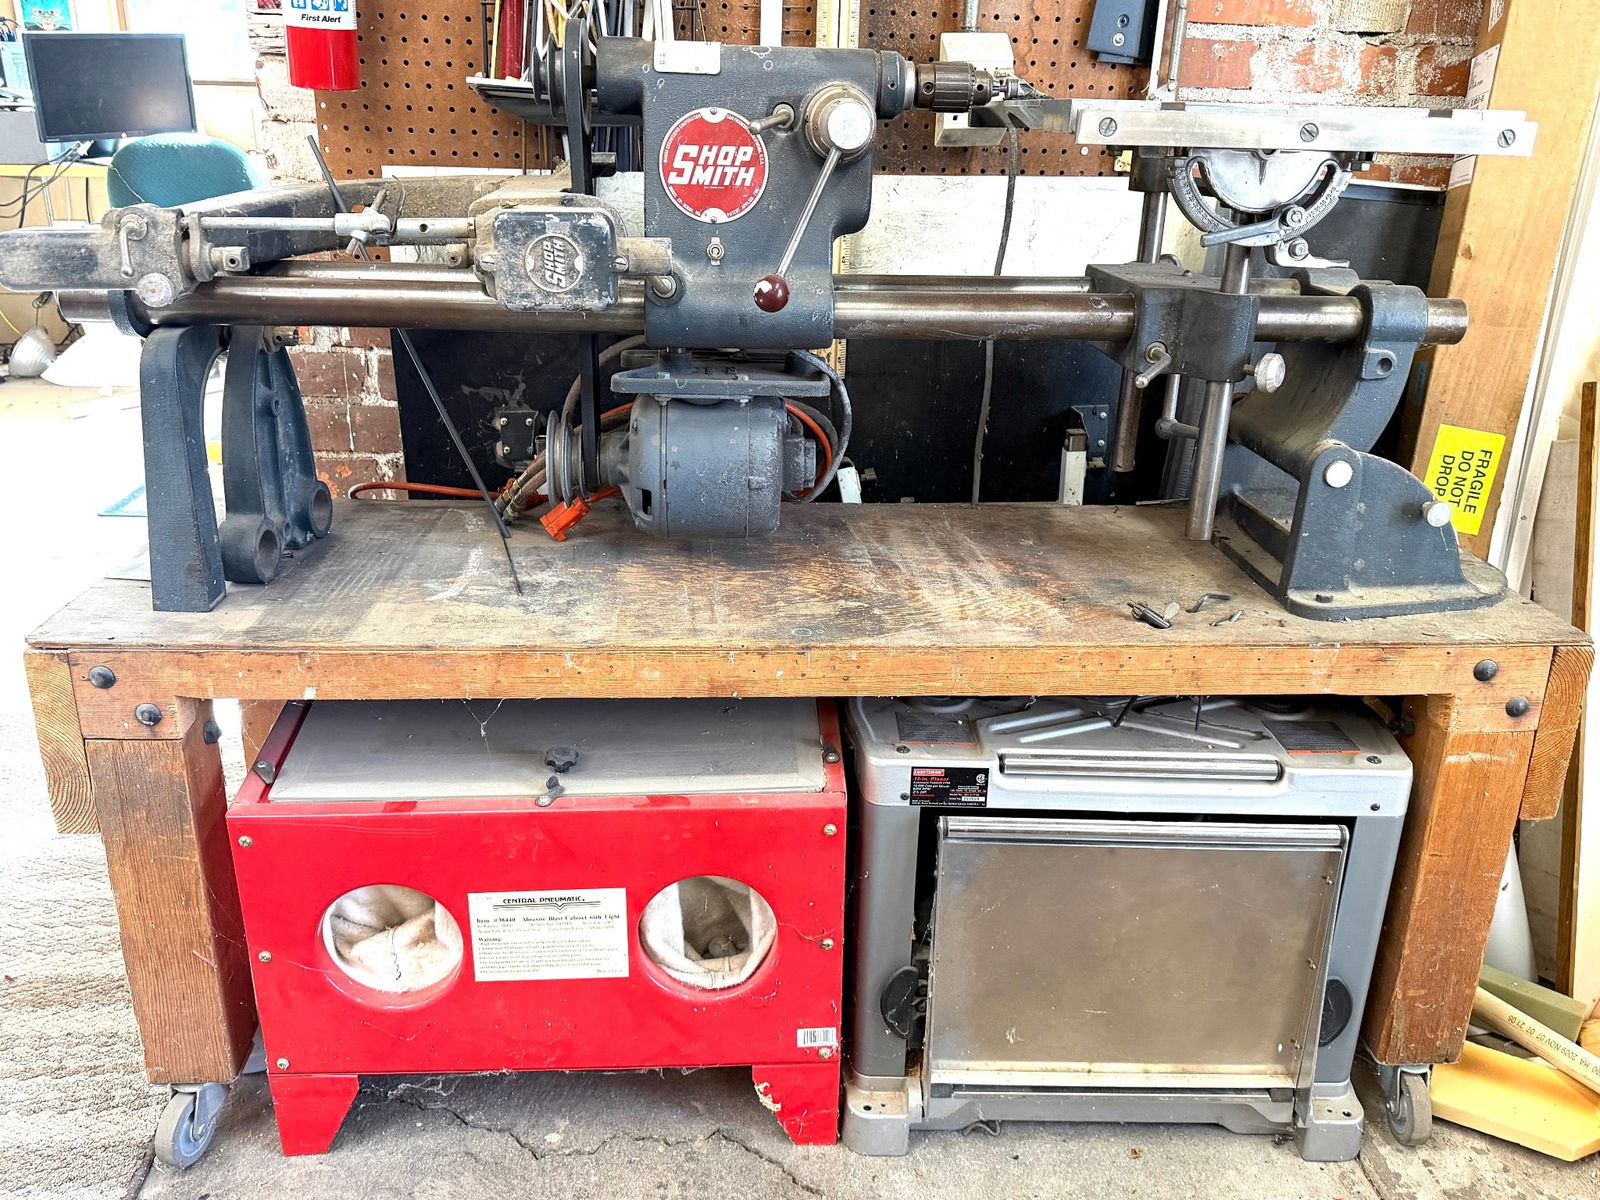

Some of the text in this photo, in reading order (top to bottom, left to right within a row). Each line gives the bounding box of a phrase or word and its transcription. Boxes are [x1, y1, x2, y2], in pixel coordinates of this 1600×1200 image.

[301, 14, 320, 22] First
[668, 144, 754, 173] SHOP
[668, 160, 756, 186] SMITH
[1434, 454, 1456, 497] DROP
[1448, 450, 1474, 508] DO NOT
[1464, 450, 1492, 514] FRAGILE
[1546, 1038, 1562, 1051] NOV
[1560, 1048, 1578, 1062] 2009
